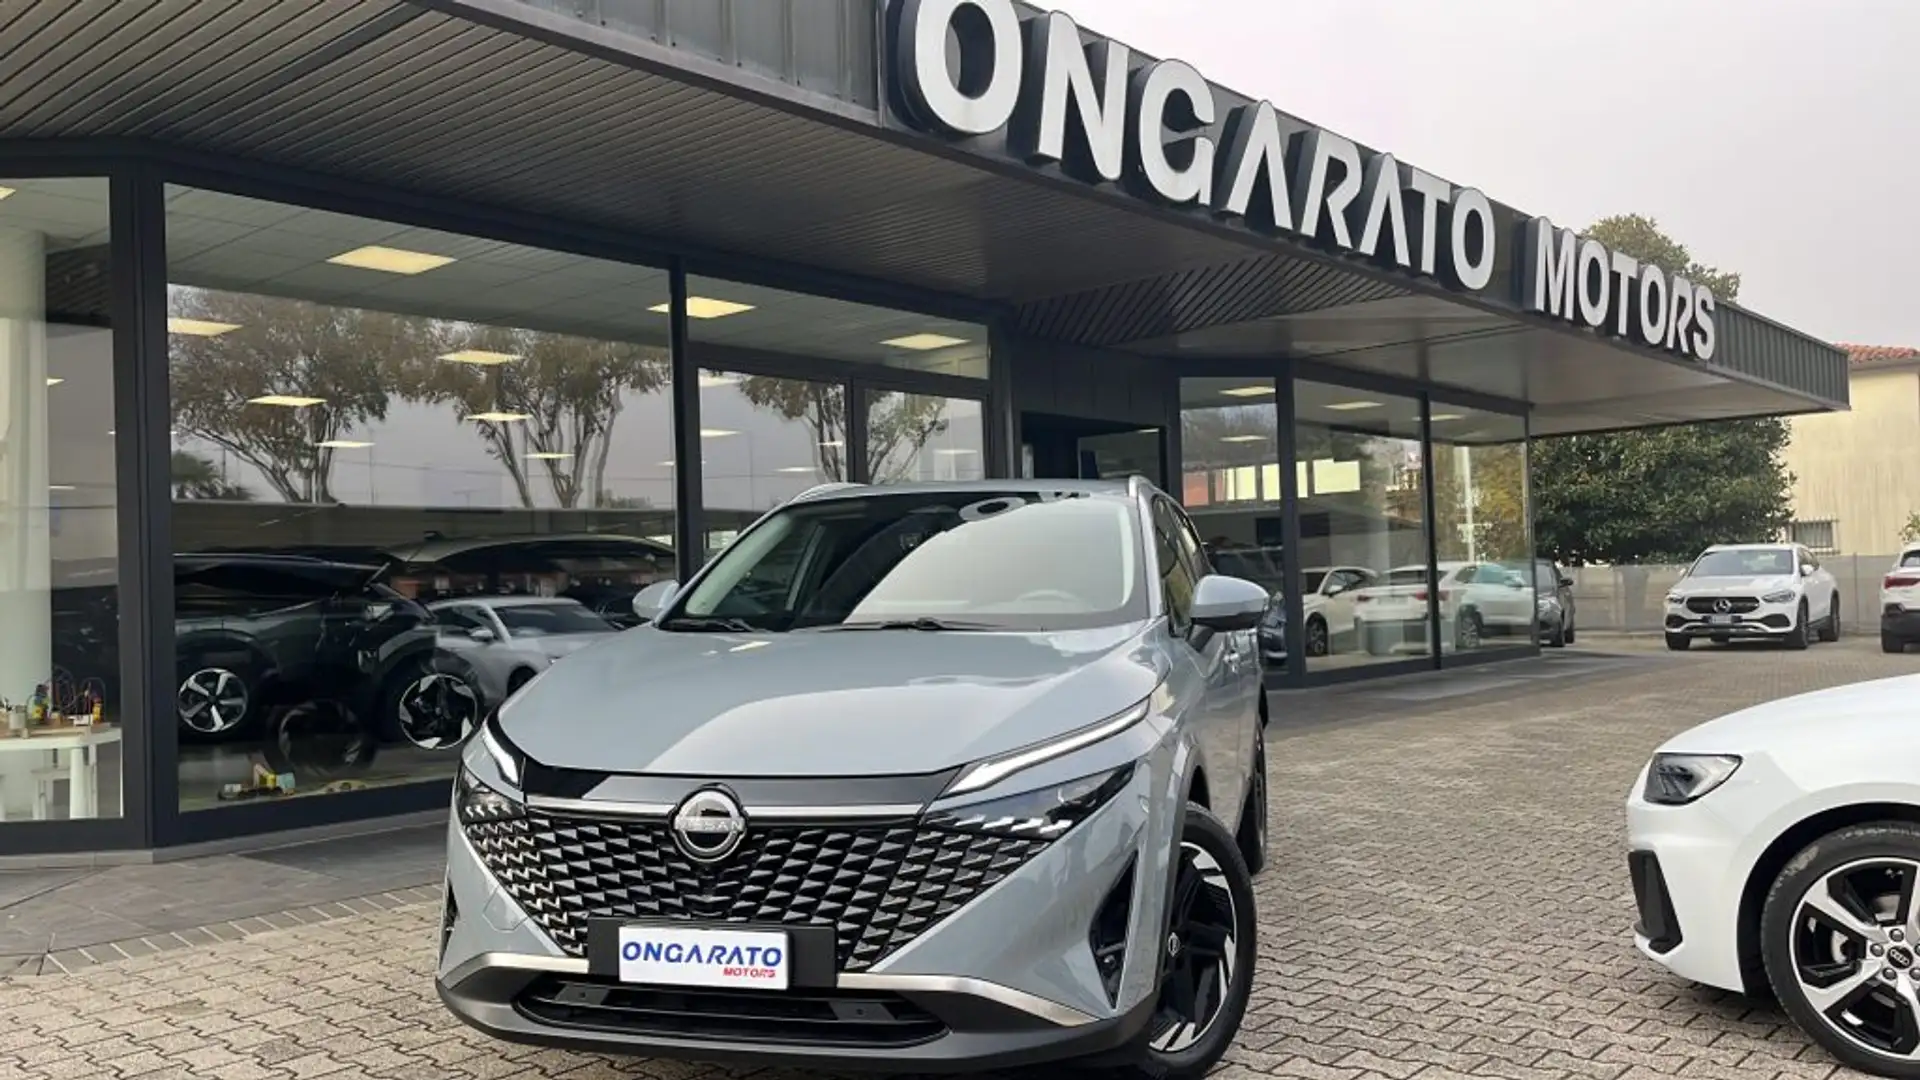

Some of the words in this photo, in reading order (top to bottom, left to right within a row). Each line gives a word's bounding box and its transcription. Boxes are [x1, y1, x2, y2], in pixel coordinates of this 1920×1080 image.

[915, 0, 1495, 290] ONGARATO
[1535, 218, 1715, 360] MOTORS
[622, 941, 782, 967] ONGARATO
[723, 967, 776, 978] MOTORS
